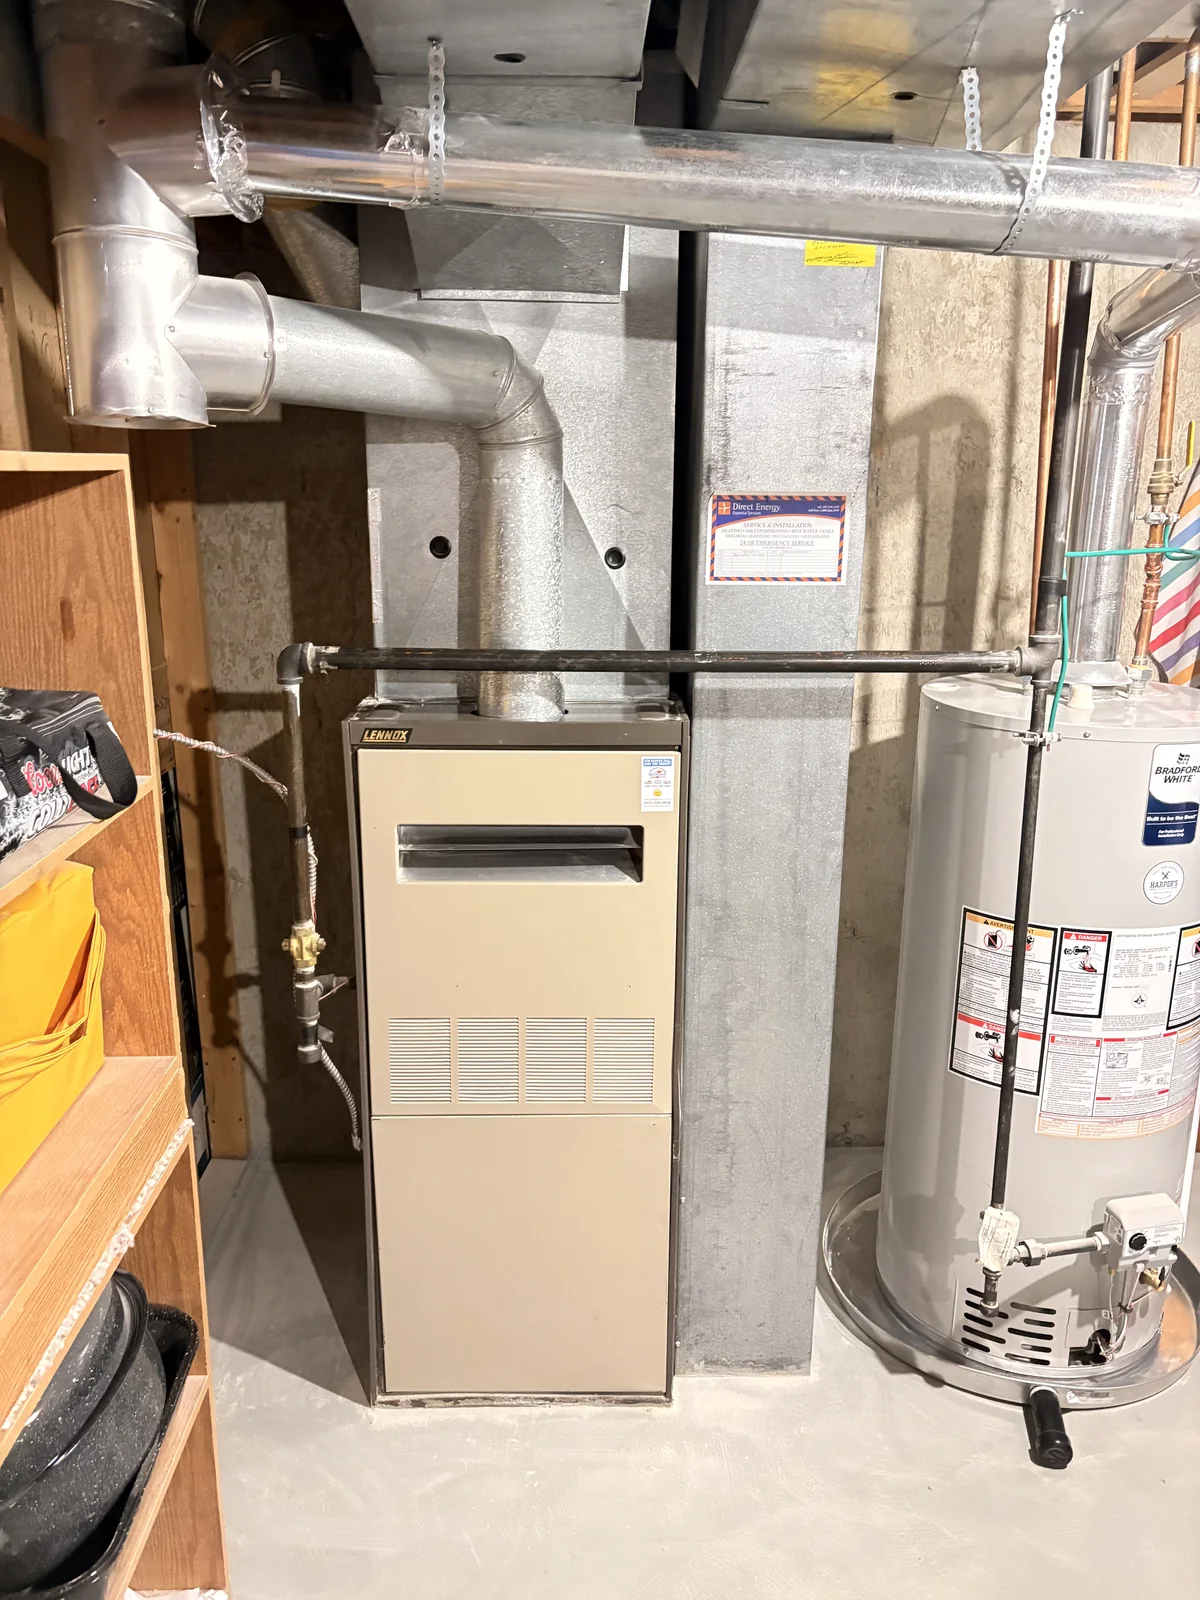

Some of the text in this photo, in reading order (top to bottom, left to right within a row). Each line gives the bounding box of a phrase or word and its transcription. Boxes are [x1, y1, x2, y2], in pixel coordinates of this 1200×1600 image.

[732, 502, 781, 513] Direct Energy
[363, 730, 409, 740] LENNOX
[21, 760, 63, 797] Coor
[1163, 774, 1193, 784] WHITE
[1149, 880, 1179, 888] HARPER'S
[1077, 933, 1103, 941] DANGER
